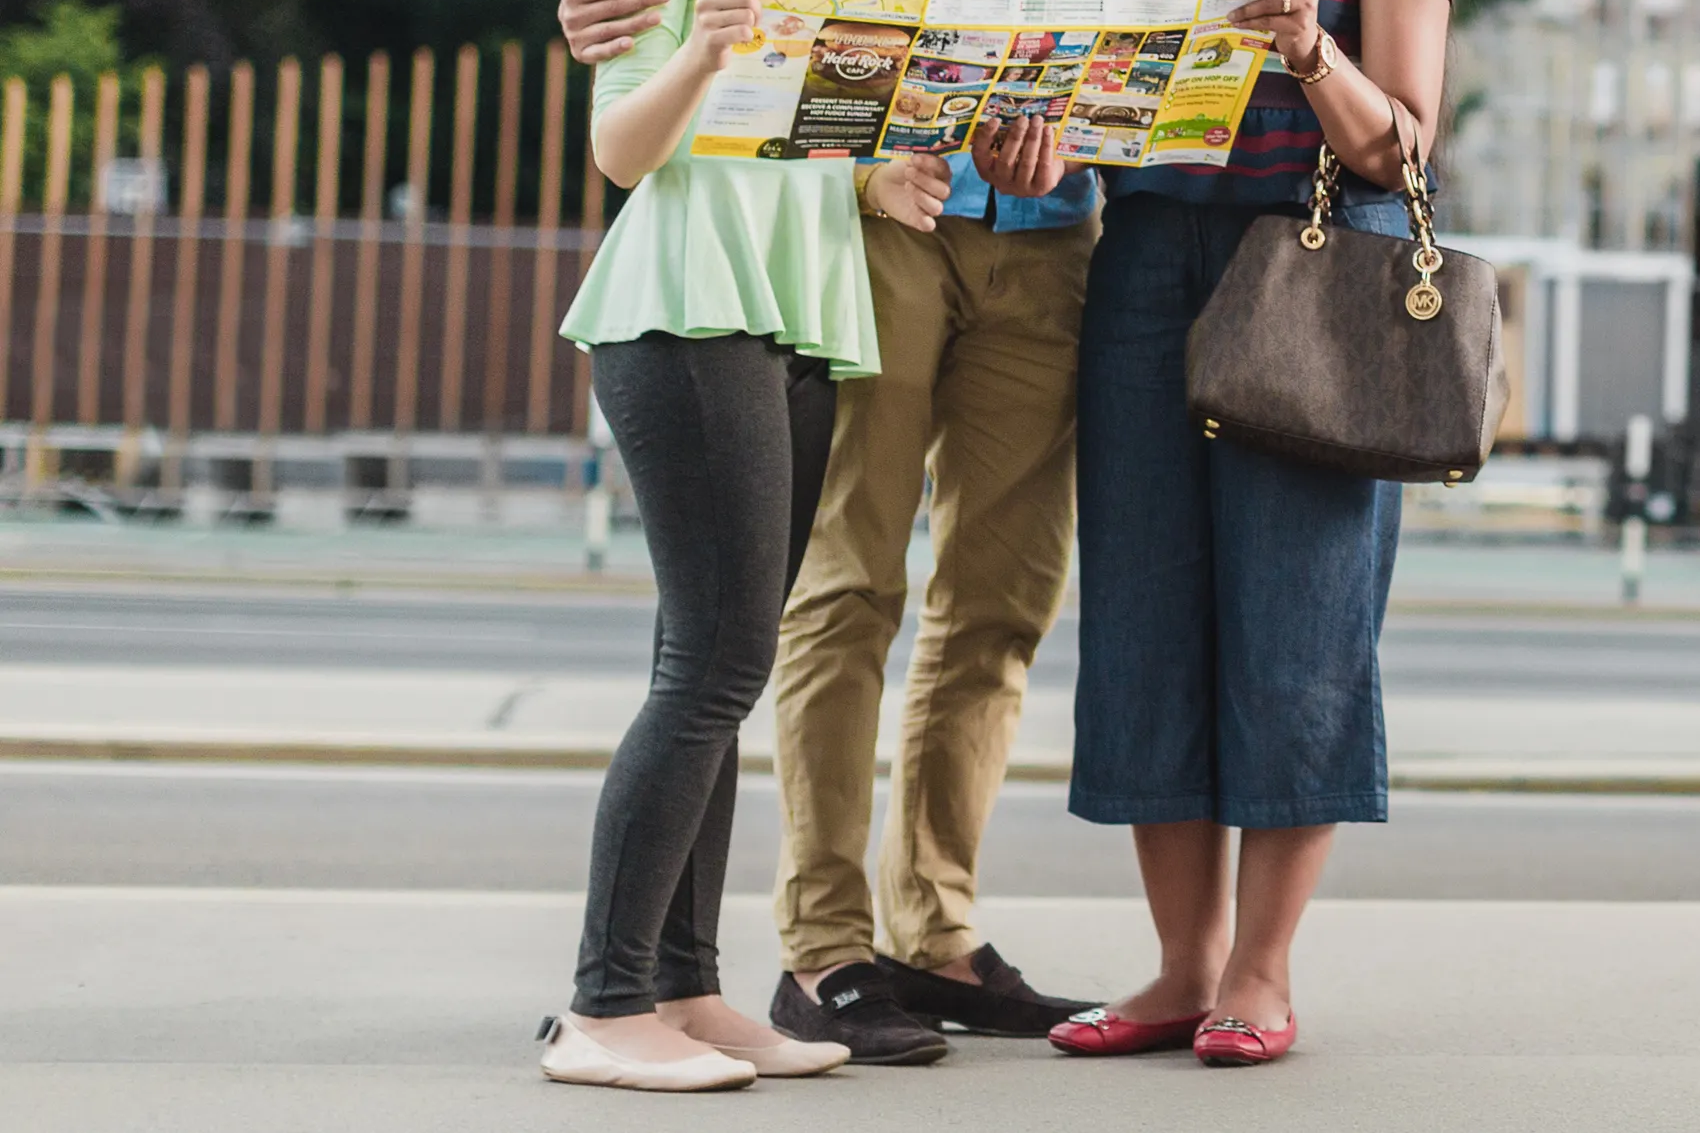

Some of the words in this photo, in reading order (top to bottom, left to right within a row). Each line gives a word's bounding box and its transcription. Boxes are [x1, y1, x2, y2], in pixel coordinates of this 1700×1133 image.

[821, 51, 858, 66] Hard
[858, 55, 893, 71] Rock
[846, 67, 864, 75] CAFE
[1175, 77, 1190, 85] HOP
[1223, 75, 1239, 83] OFF
[810, 97, 838, 105] PRESENT
[1412, 294, 1434, 308] MK
